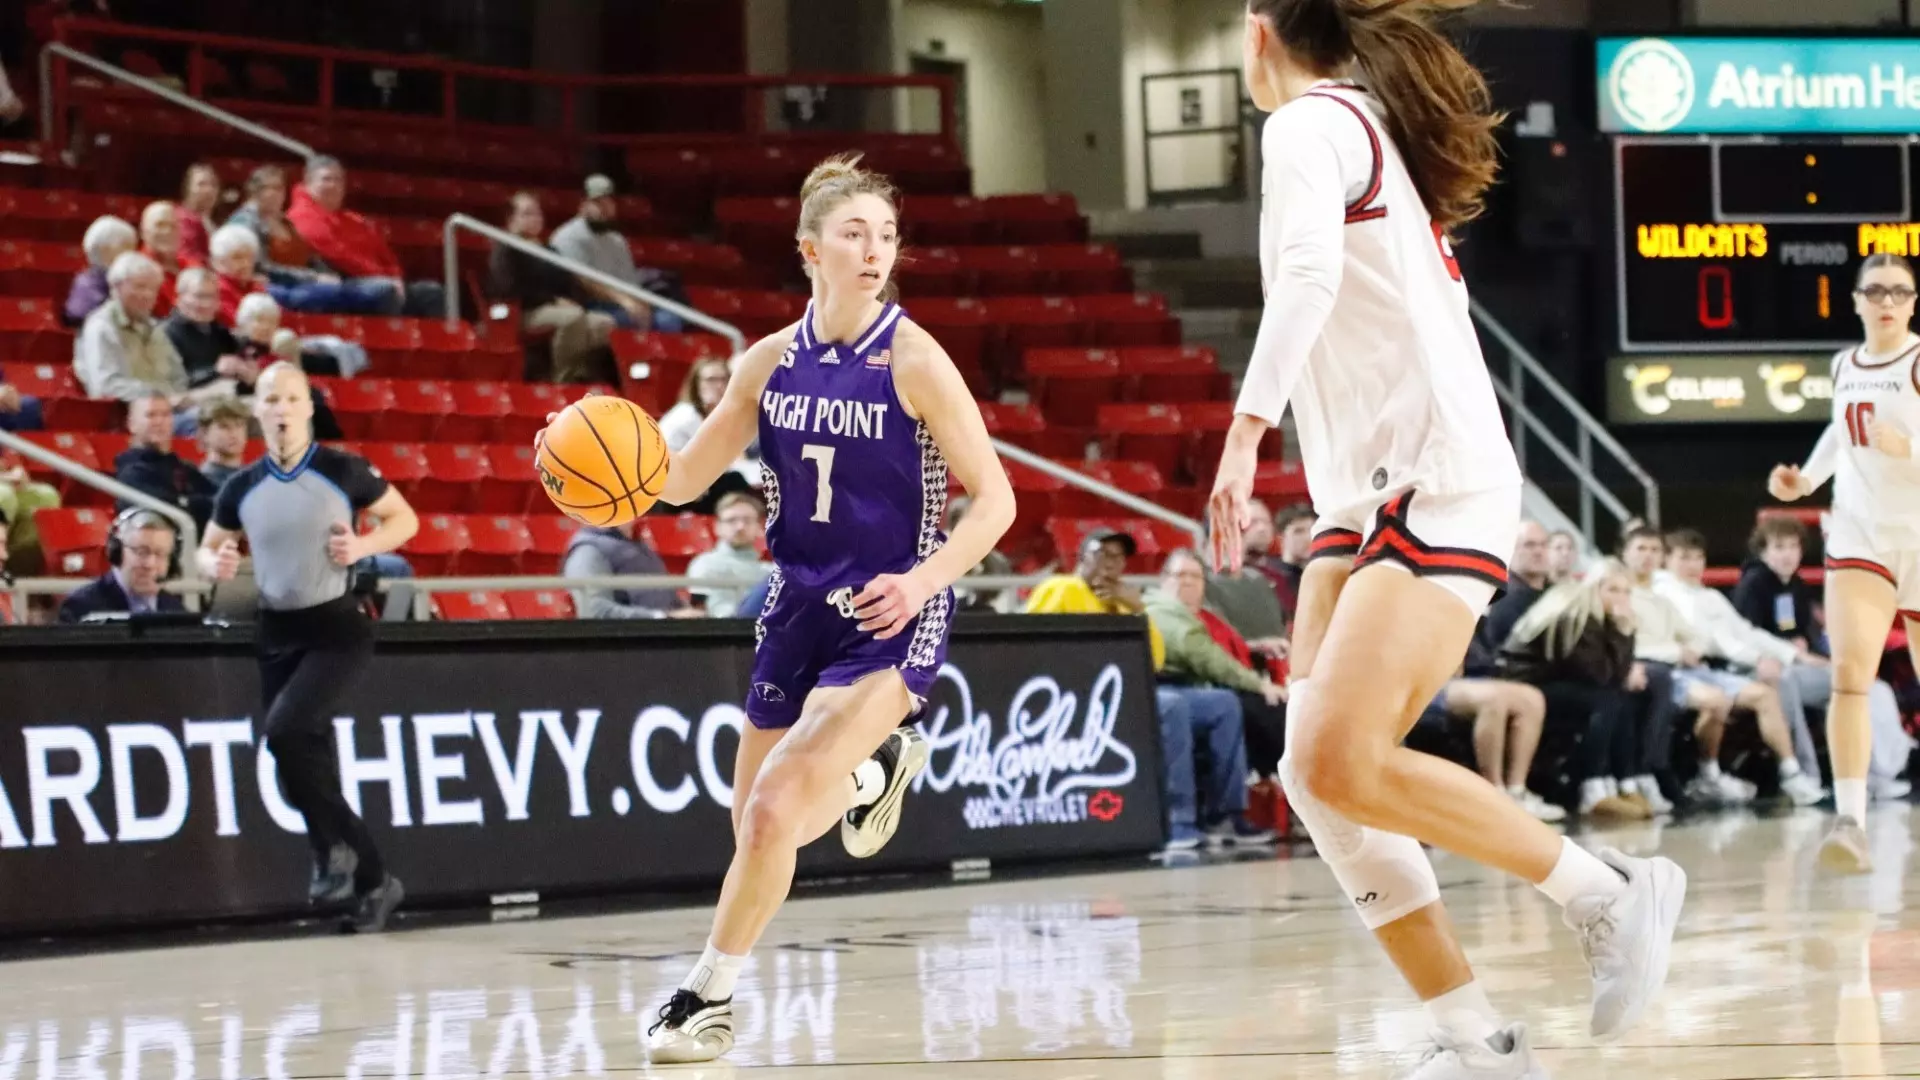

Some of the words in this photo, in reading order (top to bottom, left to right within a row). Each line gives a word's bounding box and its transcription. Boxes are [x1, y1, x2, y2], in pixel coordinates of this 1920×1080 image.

[1707, 60, 1866, 110] Atrium
[1637, 223, 1768, 258] WILDCATS
[1780, 242, 1848, 265] PERIOD
[1858, 222, 1920, 257] PANT
[1818, 273, 1831, 319] 1
[1838, 380, 1903, 394] AVIDSON
[762, 390, 812, 432] HIGH
[812, 396, 889, 440] POINT
[989, 793, 1087, 829] CHEVROLET
